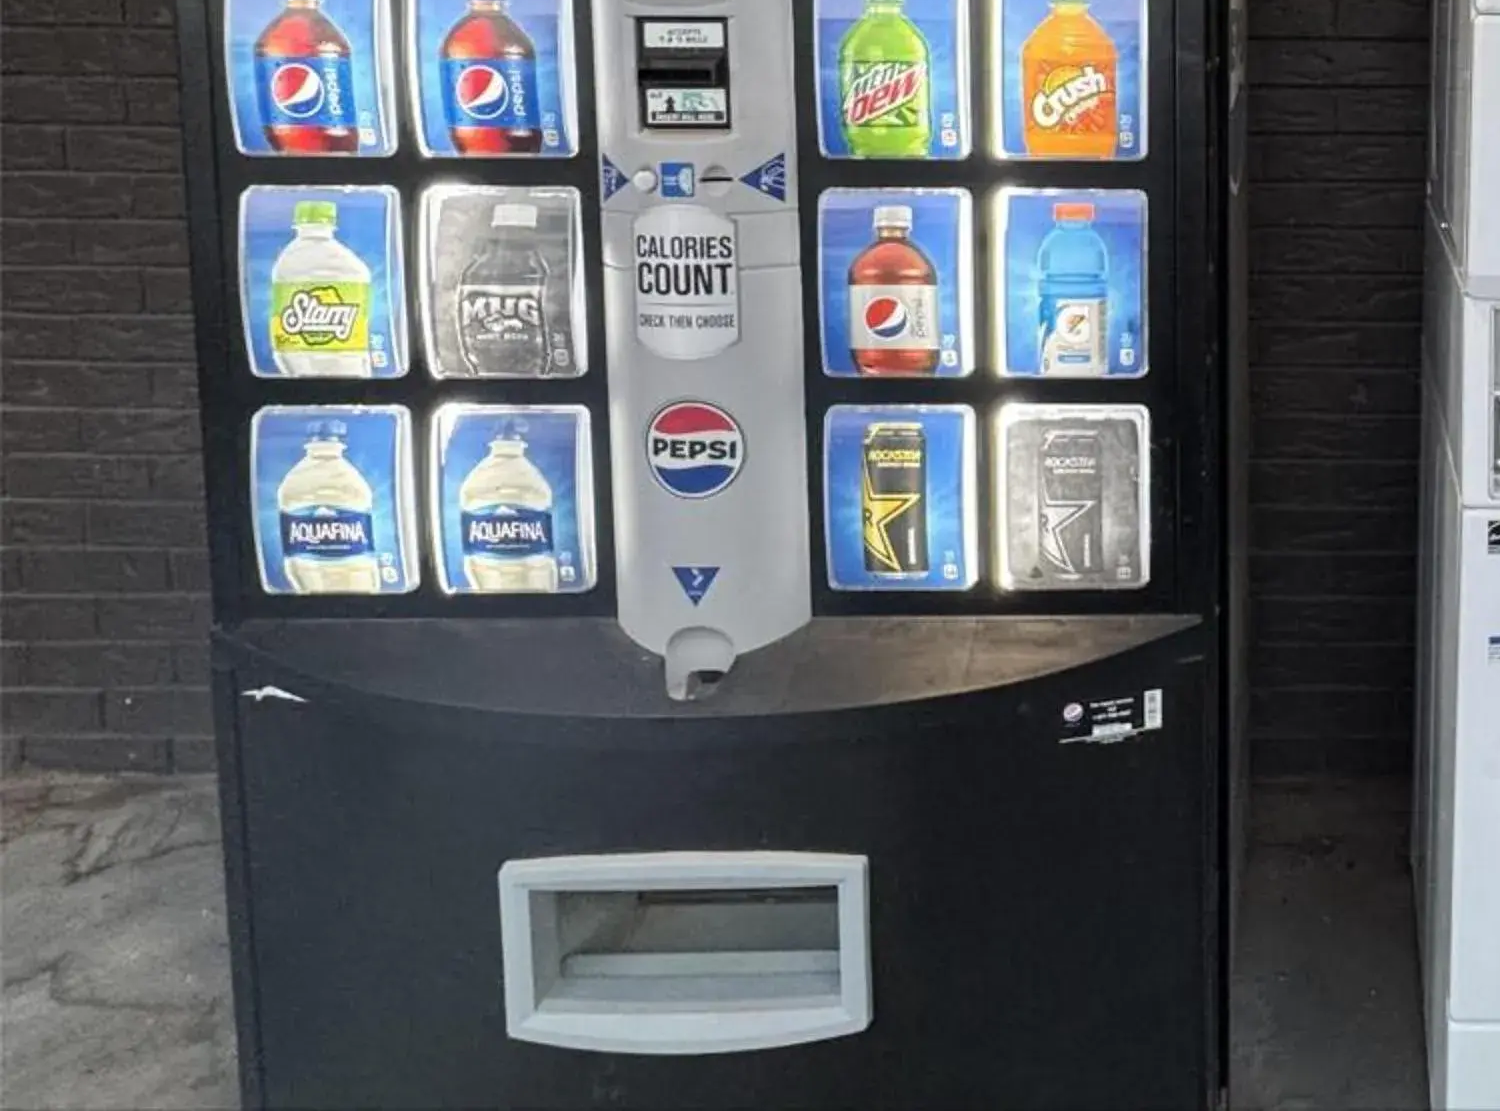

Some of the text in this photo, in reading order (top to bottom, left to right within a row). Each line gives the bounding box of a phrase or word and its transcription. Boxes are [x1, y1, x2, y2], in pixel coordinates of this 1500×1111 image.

[323, 67, 343, 116] pepsi
[508, 69, 527, 117] pepsi
[1032, 65, 1108, 128] Crush
[636, 234, 733, 260] CALORIES
[638, 262, 733, 296] COUNT
[461, 295, 541, 327] MUG
[639, 314, 735, 329] CHECK THEN CHOOSE
[652, 437, 738, 461] PEPSI
[289, 521, 368, 545] AQUAFINA
[469, 520, 548, 544] AQUAFINA
